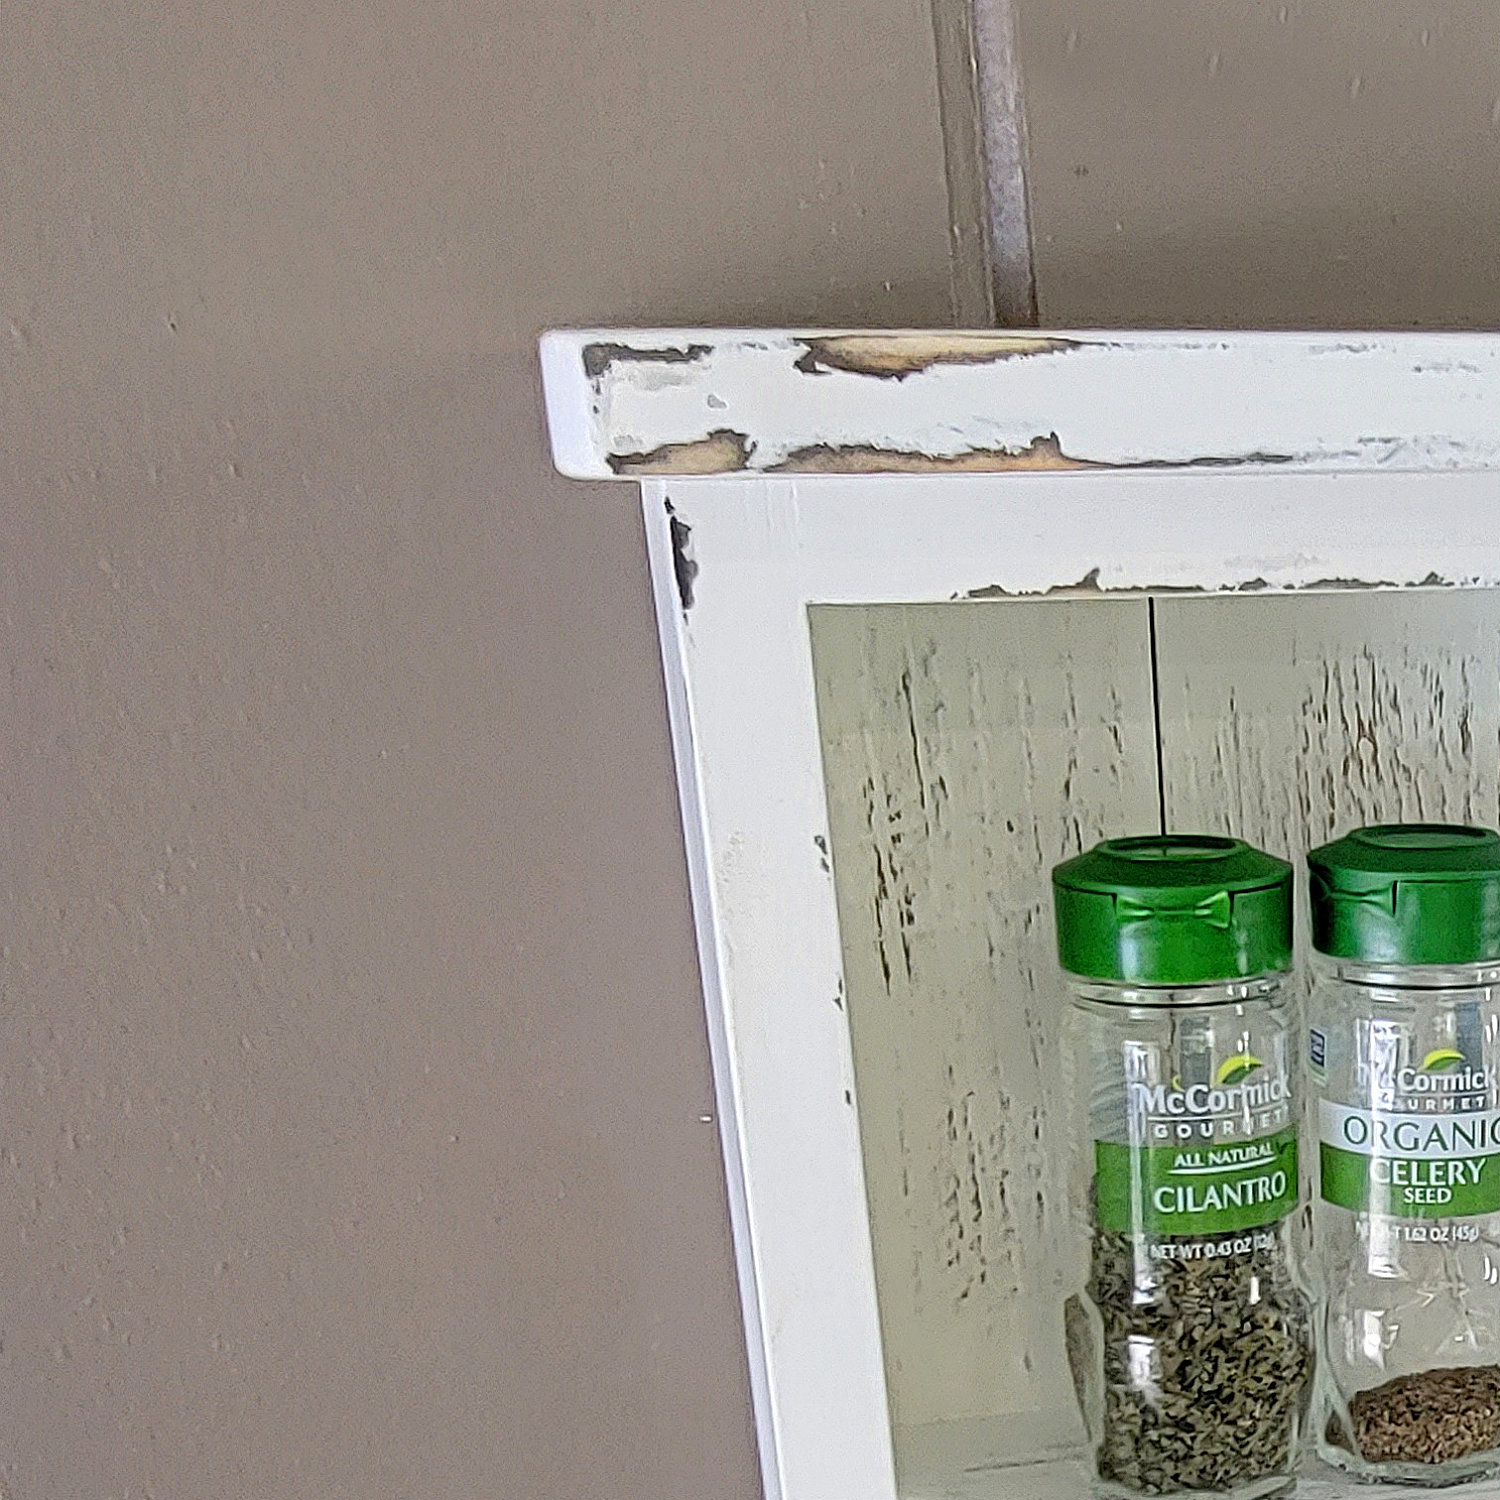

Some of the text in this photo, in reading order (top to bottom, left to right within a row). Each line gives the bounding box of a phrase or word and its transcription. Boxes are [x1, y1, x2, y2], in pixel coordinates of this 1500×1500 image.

[1131, 1072, 1292, 1116] McCormick
[1174, 1143, 1273, 1167] ALL NATURAL
[1372, 1158, 1486, 1185] CELERY
[1153, 1170, 1286, 1213] CILANTRO
[1404, 1187, 1452, 1204] SEED
[1430, 1226, 1448, 1242] OZ
[1180, 1244, 1201, 1259] WT
